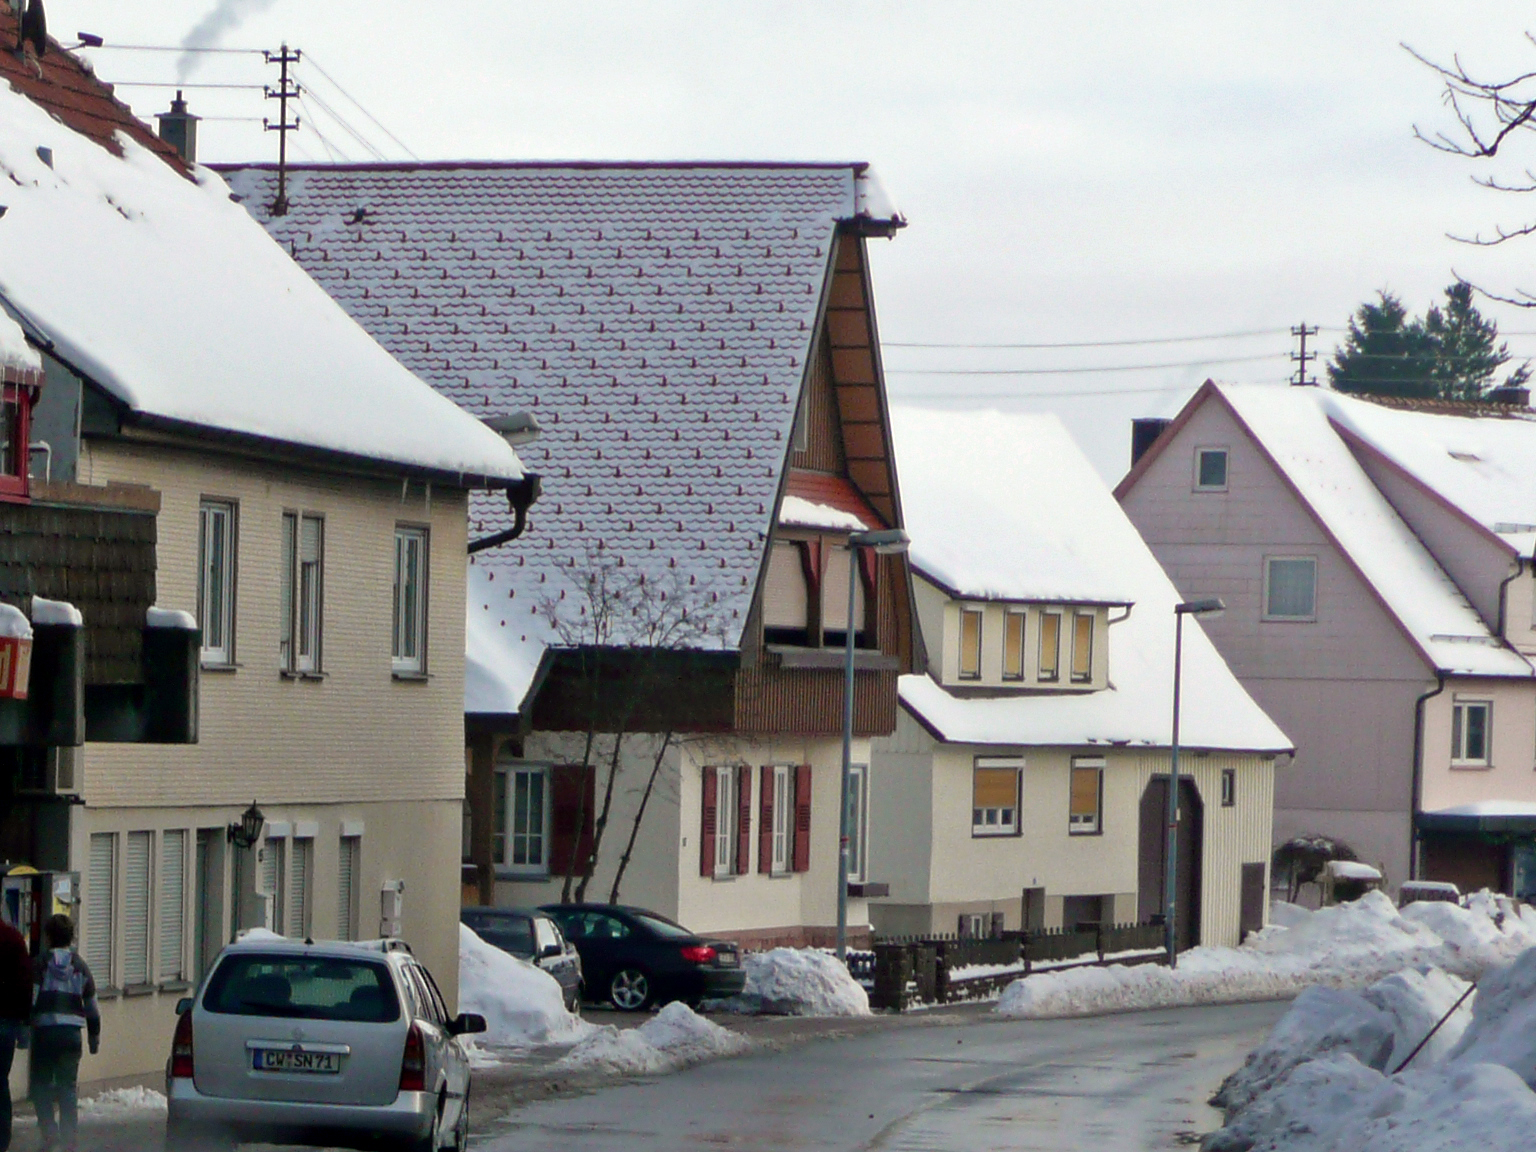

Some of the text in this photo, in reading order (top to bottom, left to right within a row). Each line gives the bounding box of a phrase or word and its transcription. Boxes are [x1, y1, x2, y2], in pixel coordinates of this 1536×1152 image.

[266, 1052, 332, 1069] CW SN 71
